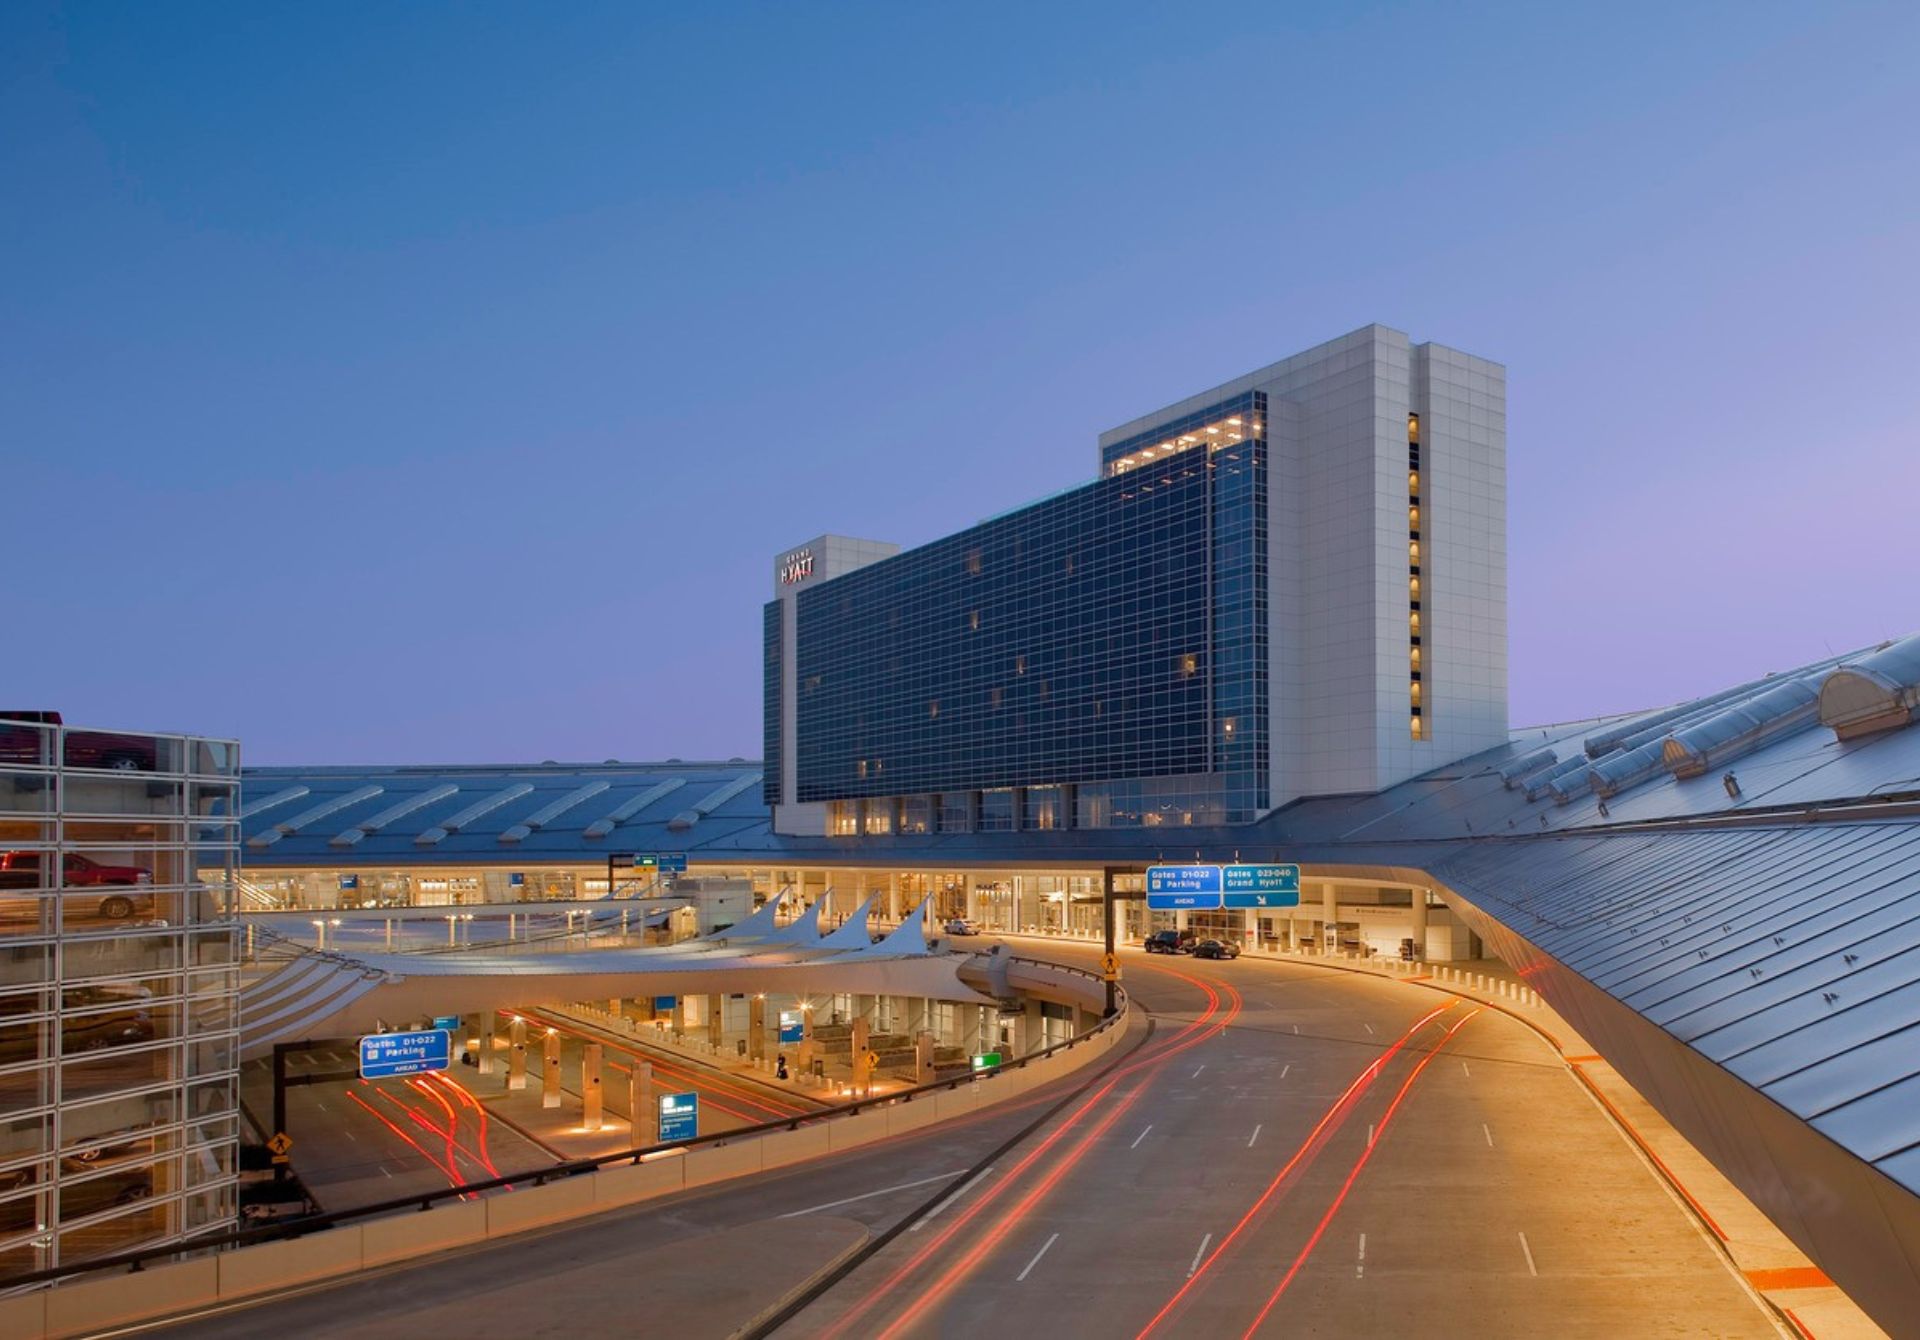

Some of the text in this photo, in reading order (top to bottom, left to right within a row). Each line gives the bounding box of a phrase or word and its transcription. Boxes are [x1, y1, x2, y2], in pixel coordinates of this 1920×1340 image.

[781, 556, 813, 583] HYATT
[1152, 871, 1176, 879] Gates
[1227, 870, 1252, 878] Gates
[1167, 880, 1201, 890] Parking
[1227, 878, 1283, 888] Grand Hyatt
[367, 1039, 396, 1049] Gates
[385, 1047, 425, 1058] Parking
[394, 1064, 418, 1073] AHEAD
